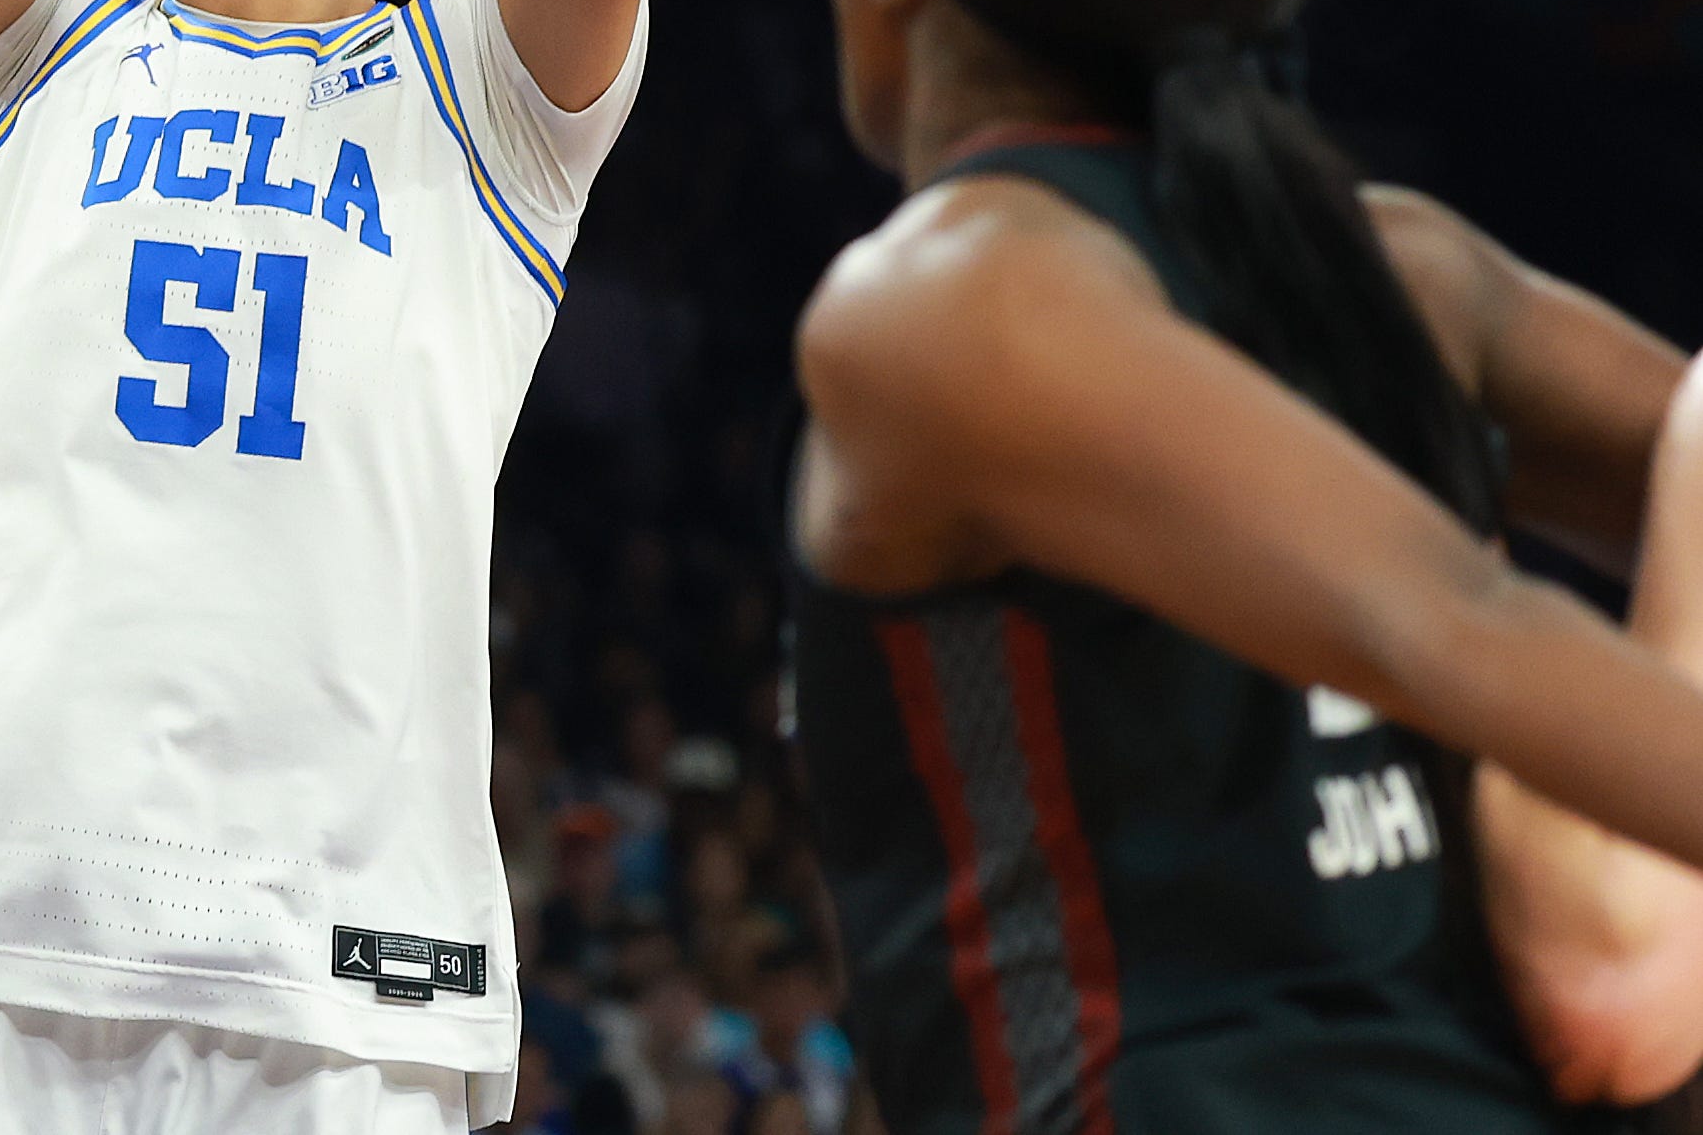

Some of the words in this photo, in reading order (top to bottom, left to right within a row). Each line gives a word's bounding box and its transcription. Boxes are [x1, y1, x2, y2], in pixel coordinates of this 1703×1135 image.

[81, 109, 392, 257] UCLA
[115, 239, 309, 461] 51
[1306, 764, 1441, 880] JOH
[440, 954, 462, 976] 50
